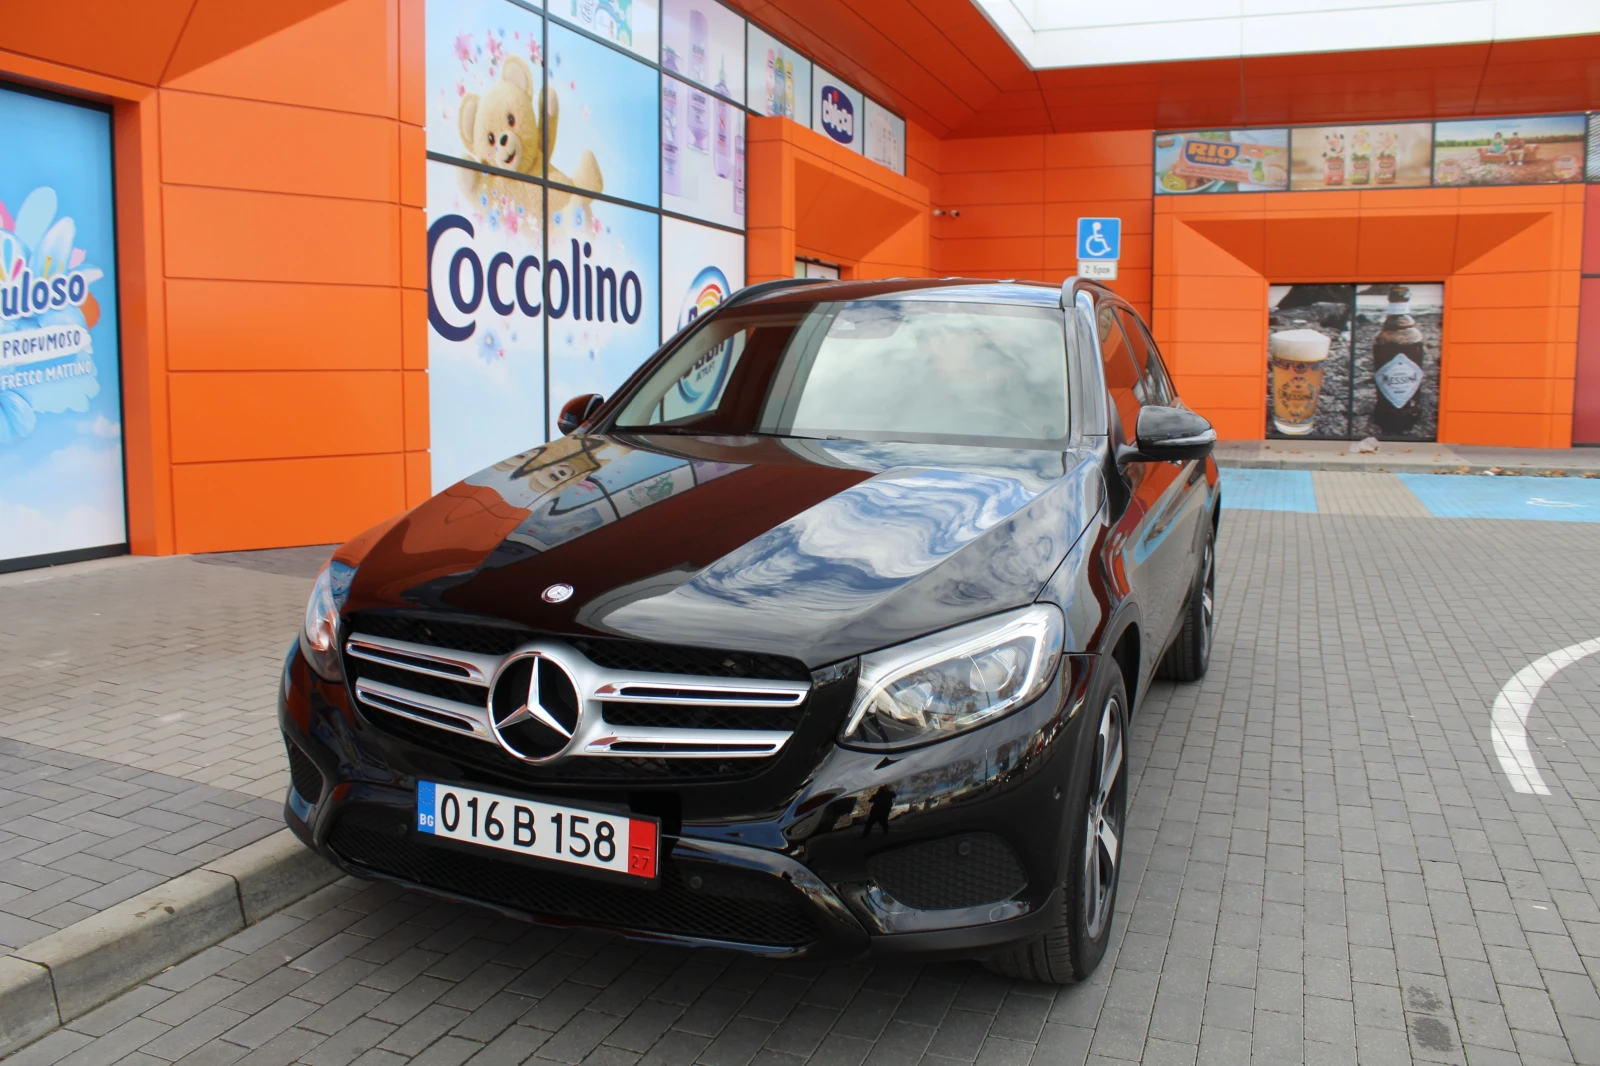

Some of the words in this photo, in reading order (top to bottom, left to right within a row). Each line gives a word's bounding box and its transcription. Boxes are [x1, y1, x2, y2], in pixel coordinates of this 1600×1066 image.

[1187, 142, 1237, 159] RIO
[427, 213, 642, 342] Coccolino
[3, 329, 81, 358] PROFUMOSO
[1, 369, 42, 391] FRESCO
[46, 361, 92, 381] MATTINO
[419, 813, 434, 827] BG
[440, 792, 504, 841] 016
[513, 805, 537, 848] B
[551, 812, 616, 863] 158
[631, 855, 649, 871] 27
